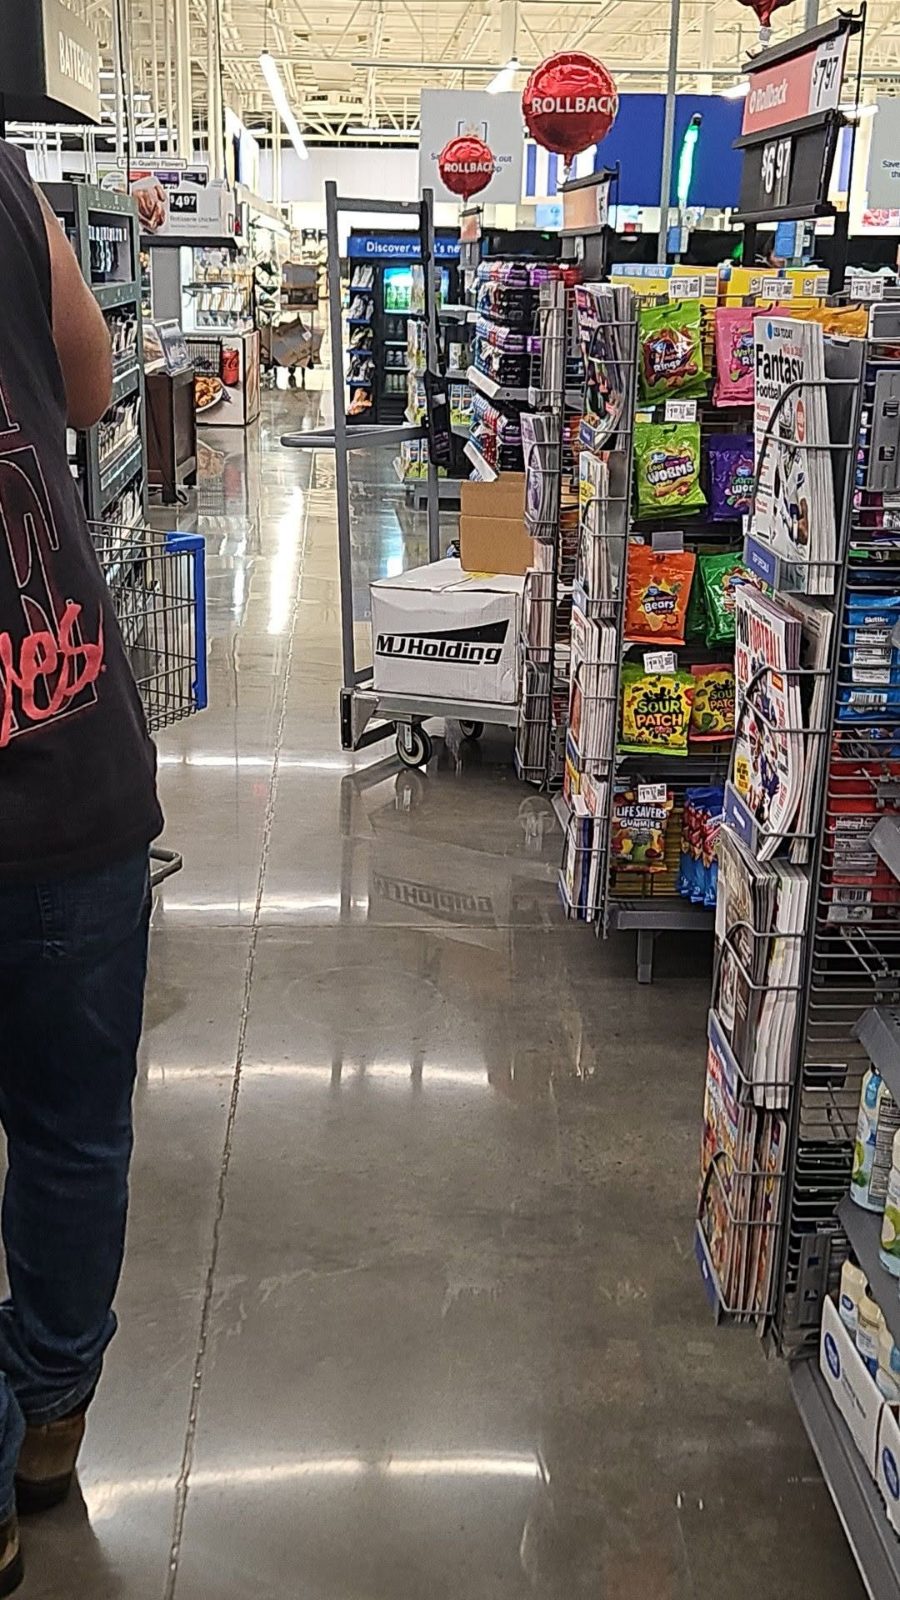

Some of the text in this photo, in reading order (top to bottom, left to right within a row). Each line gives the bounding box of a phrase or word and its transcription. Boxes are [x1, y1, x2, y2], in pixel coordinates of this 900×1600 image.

[756, 78, 788, 112] Rollback
[531, 96, 617, 114] ROLLBACK
[366, 241, 411, 253] Discover
[653, 359, 681, 373] Rings
[756, 344, 804, 397] Fantasy
[648, 461, 693, 483] WORMS
[645, 600, 674, 612] Bears
[638, 700, 680, 713] SOUR
[636, 713, 683, 727] PATCH
[617, 806, 667, 818] LIFE SAVERS
[620, 820, 660, 829] GUMMIES
